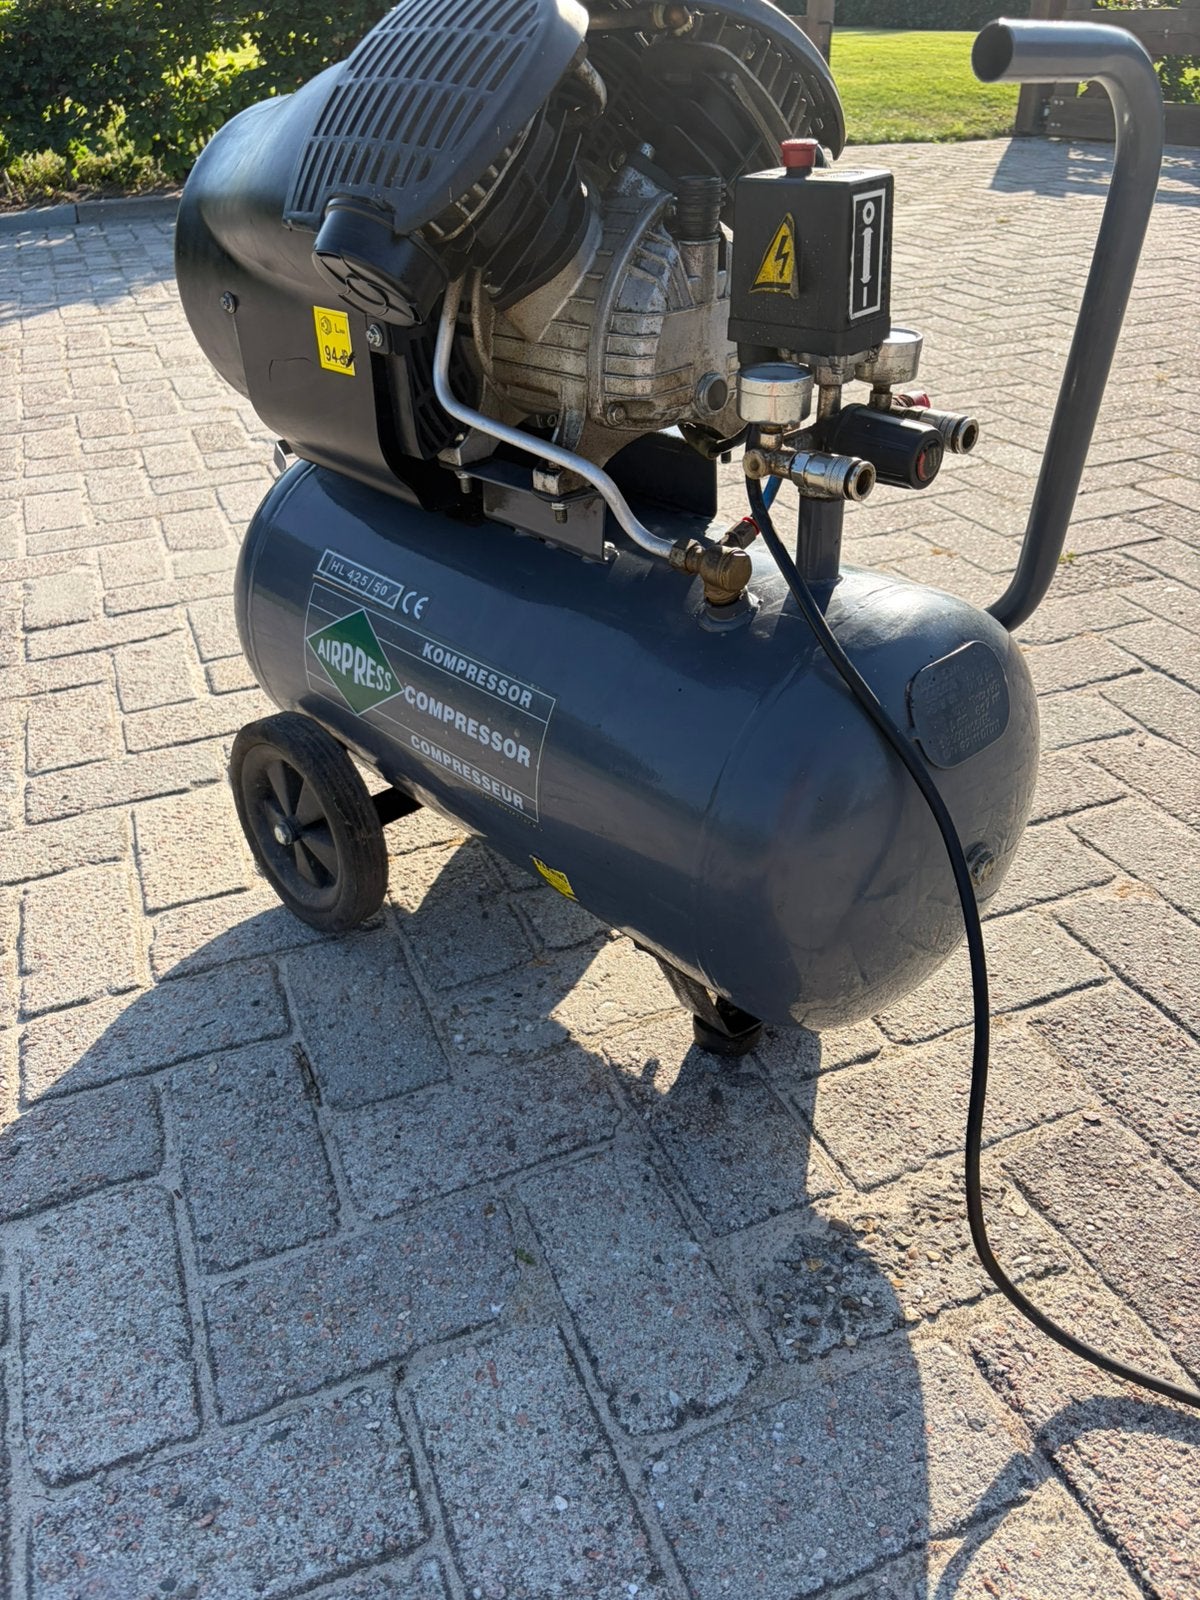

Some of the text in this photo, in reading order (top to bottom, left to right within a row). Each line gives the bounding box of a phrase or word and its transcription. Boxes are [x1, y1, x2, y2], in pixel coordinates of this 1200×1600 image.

[324, 344, 338, 364] 94
[331, 560, 345, 576] HL
[402, 591, 429, 619] CE
[317, 638, 392, 692] AIRPRESS
[422, 642, 533, 709] KOMPRESSOR
[404, 685, 531, 768] COMPRESSOR
[410, 735, 524, 810] COMPRESSEUR
